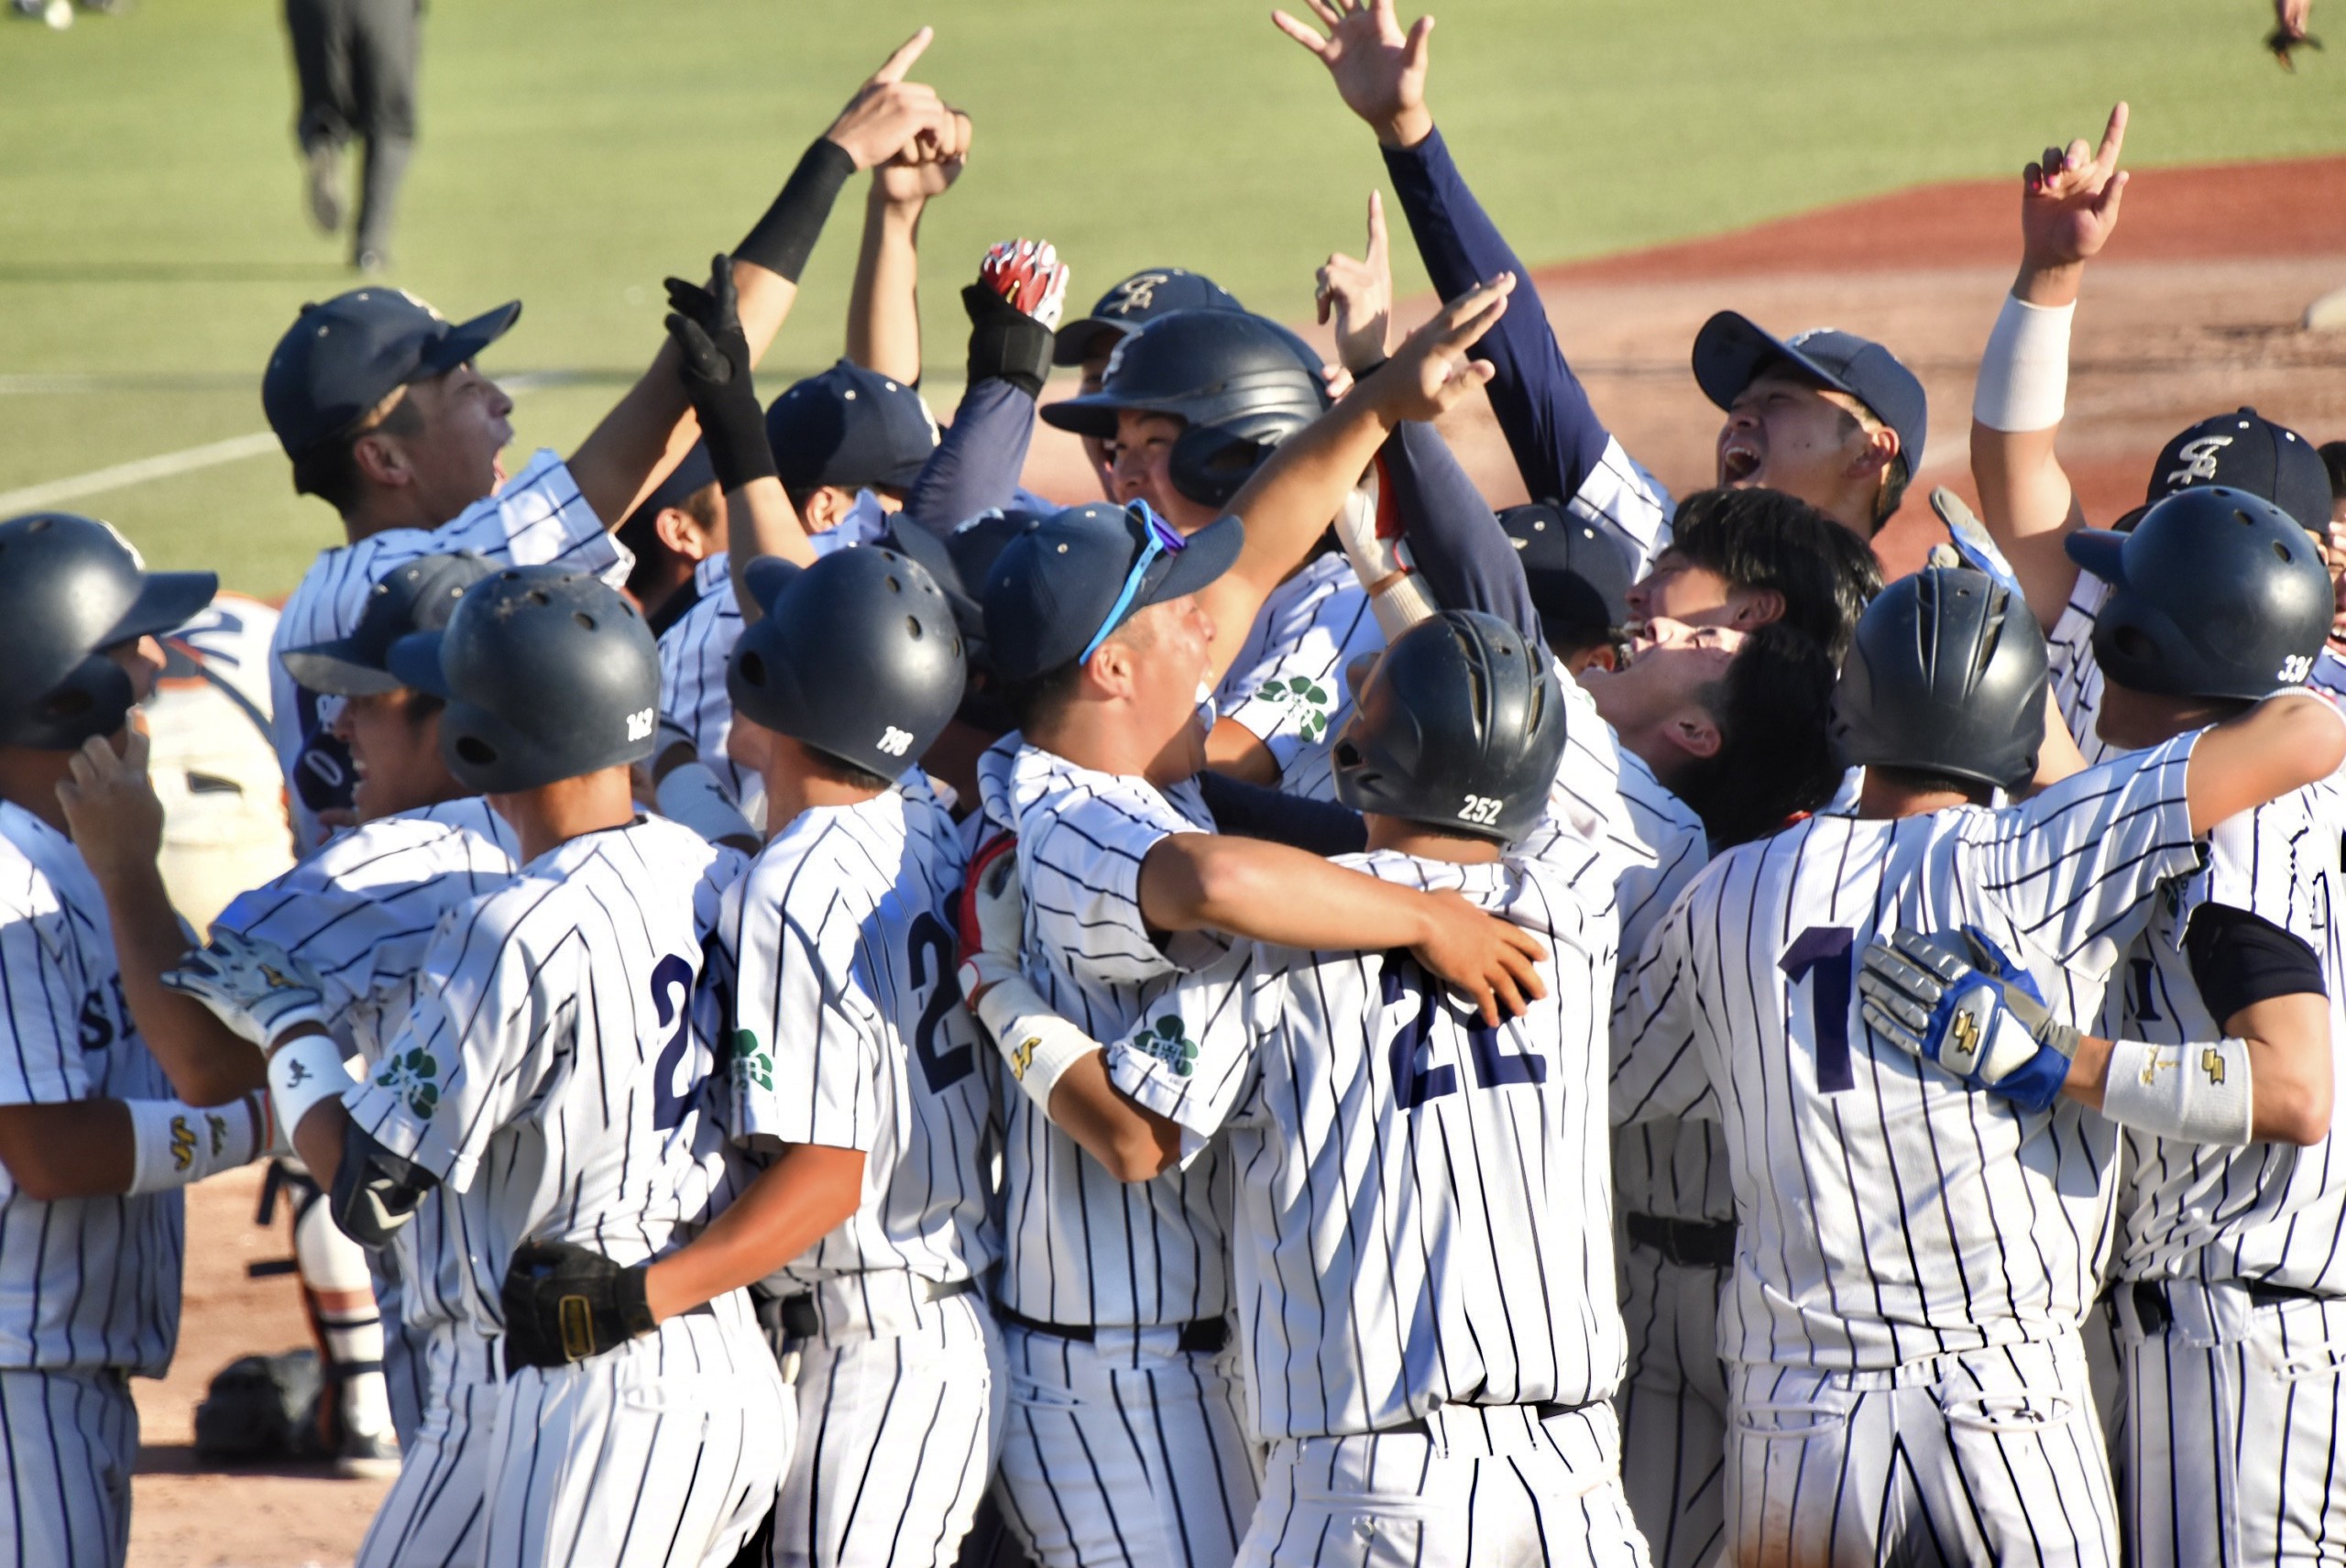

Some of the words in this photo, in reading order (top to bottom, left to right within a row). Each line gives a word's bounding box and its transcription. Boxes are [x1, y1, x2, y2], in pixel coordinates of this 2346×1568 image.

[1457, 794, 1503, 826] 252
[907, 887, 975, 1095] 2
[1777, 926, 1856, 1094] 1
